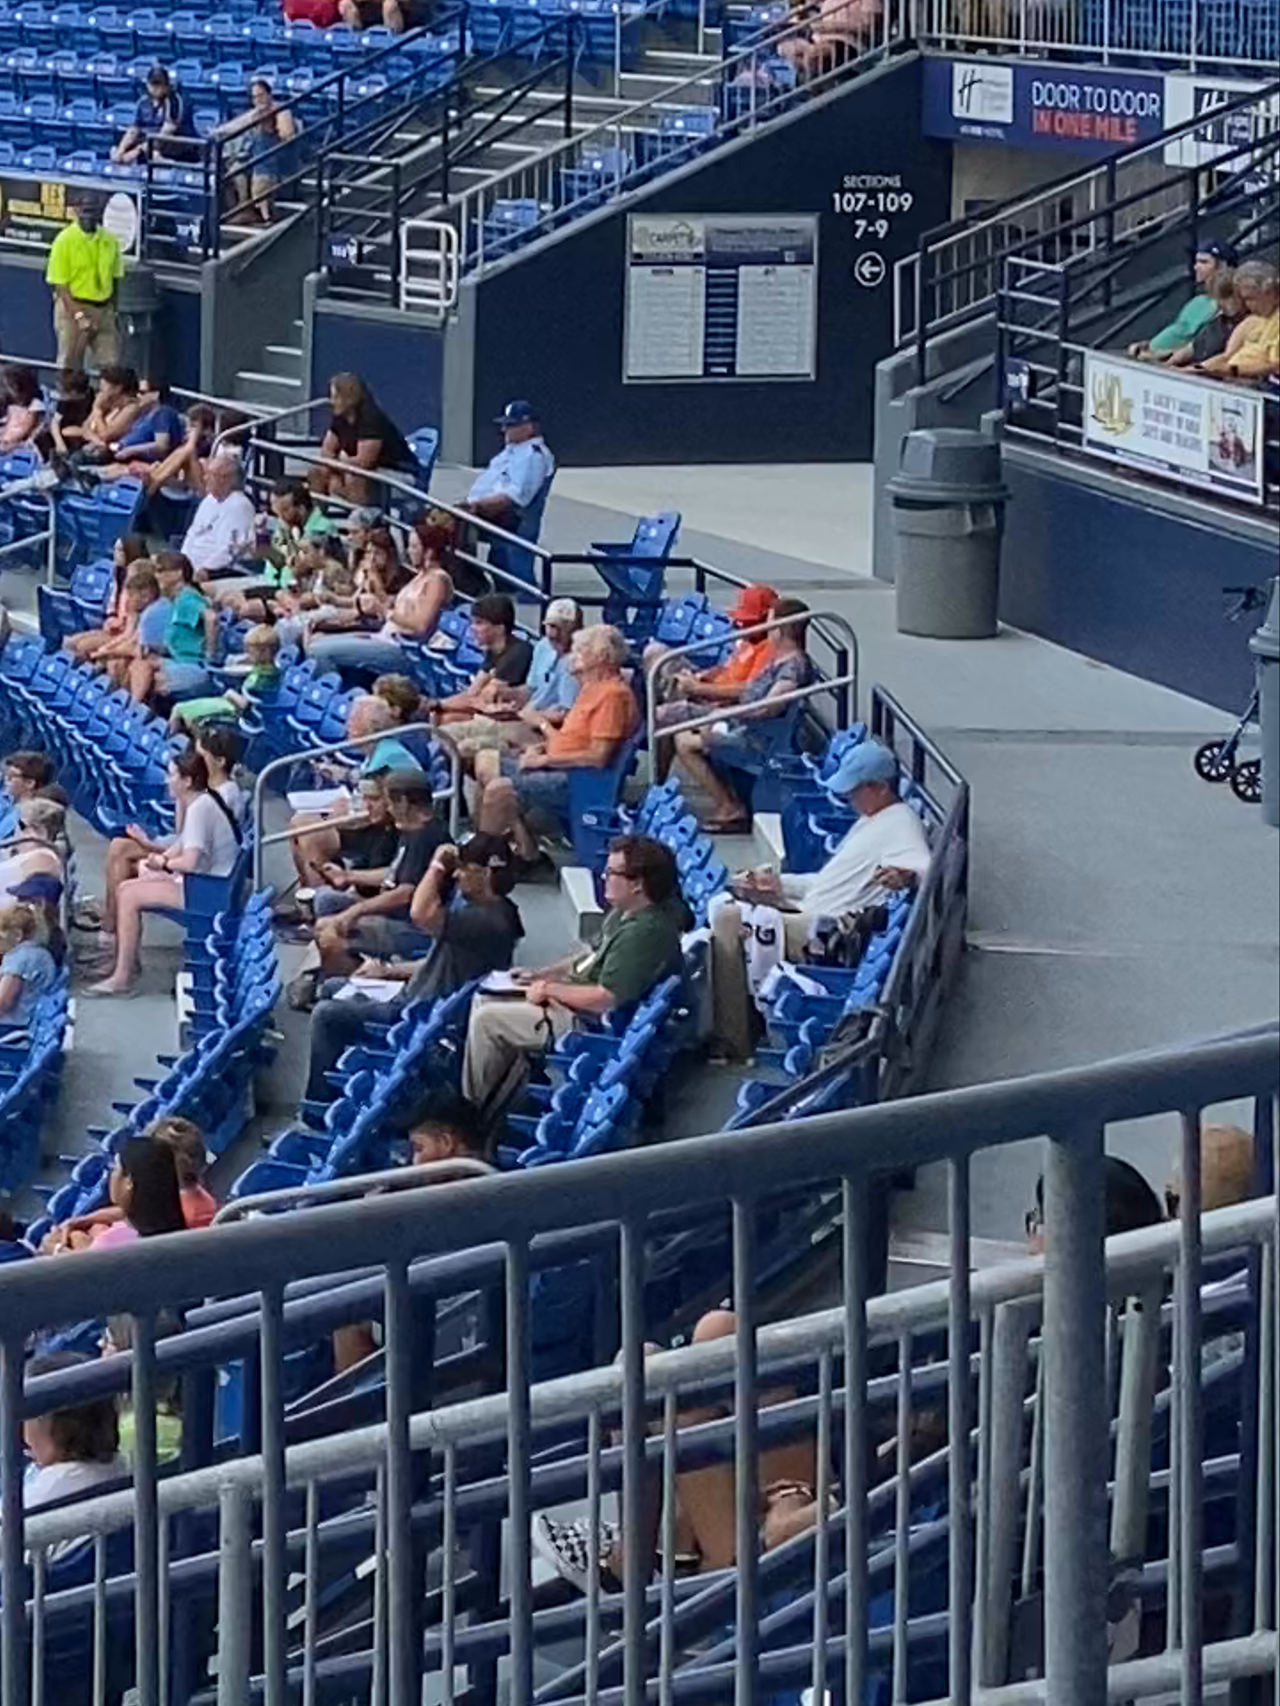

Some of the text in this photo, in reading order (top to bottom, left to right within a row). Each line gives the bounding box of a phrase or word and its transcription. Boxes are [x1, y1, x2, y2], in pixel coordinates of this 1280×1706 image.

[1032, 81, 1080, 110] DOOR
[1083, 86, 1106, 112] TO
[1110, 89, 1160, 117] DOOR
[1033, 109, 1052, 134] IN
[1054, 112, 1091, 139] ONE
[1094, 117, 1137, 143] MILE
[843, 174, 902, 188] SECTIONS
[832, 192, 913, 213] 107-109
[854, 219, 889, 239] 7-9
